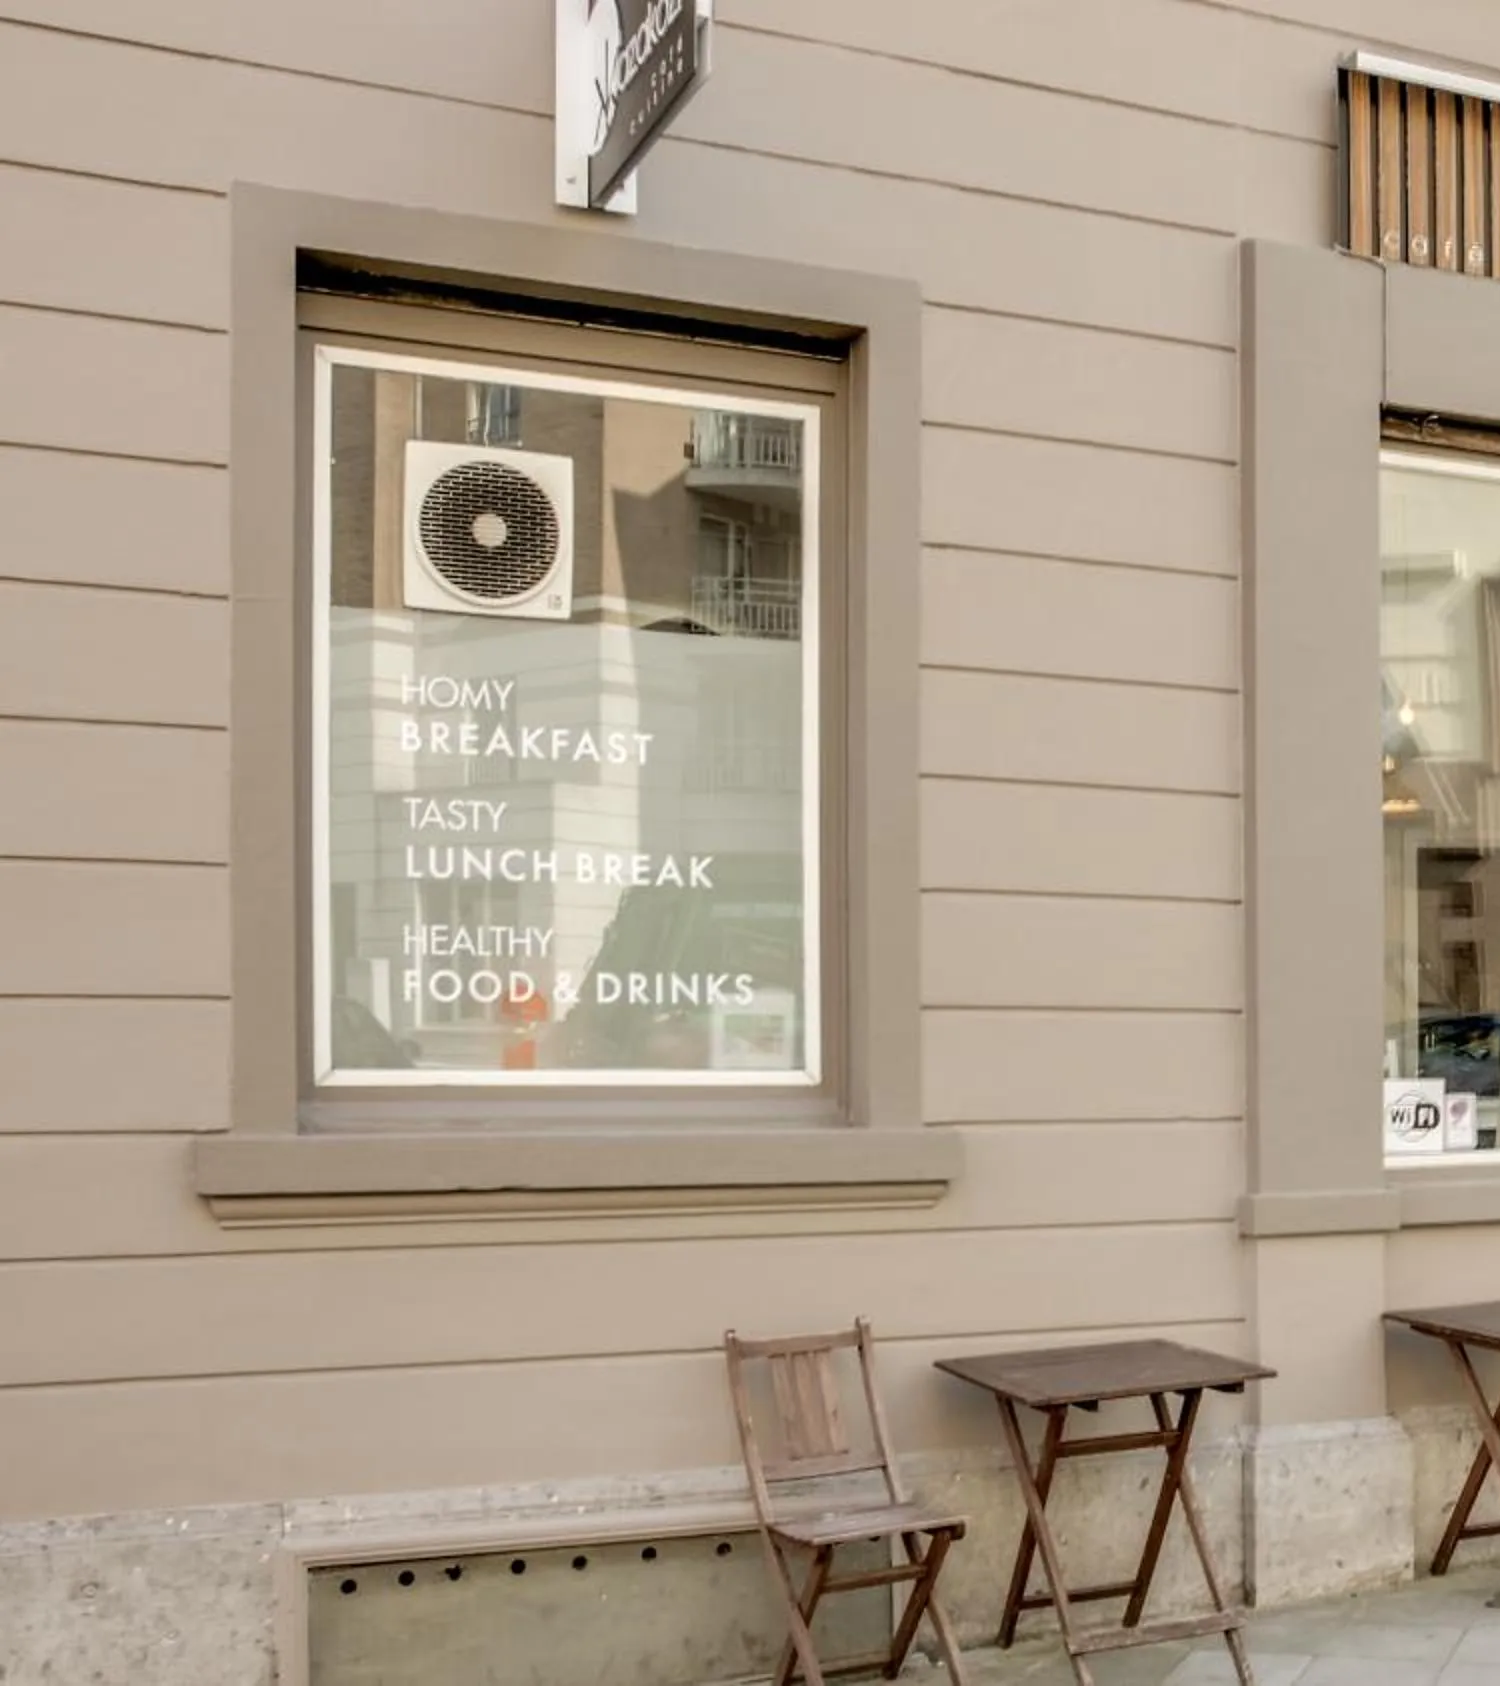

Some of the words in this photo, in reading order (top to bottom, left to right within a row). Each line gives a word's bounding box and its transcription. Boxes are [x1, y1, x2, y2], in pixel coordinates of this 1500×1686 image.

[400, 674, 515, 711] HOMY
[400, 720, 655, 766] BREAKFAST
[402, 796, 508, 833] TASTY
[405, 845, 559, 884] LUNCH
[575, 853, 715, 889] BREAK
[402, 924, 554, 959] HEALTHY
[402, 969, 536, 1005] FOOD
[552, 972, 580, 1005] &
[597, 972, 756, 1006] DRINKS
